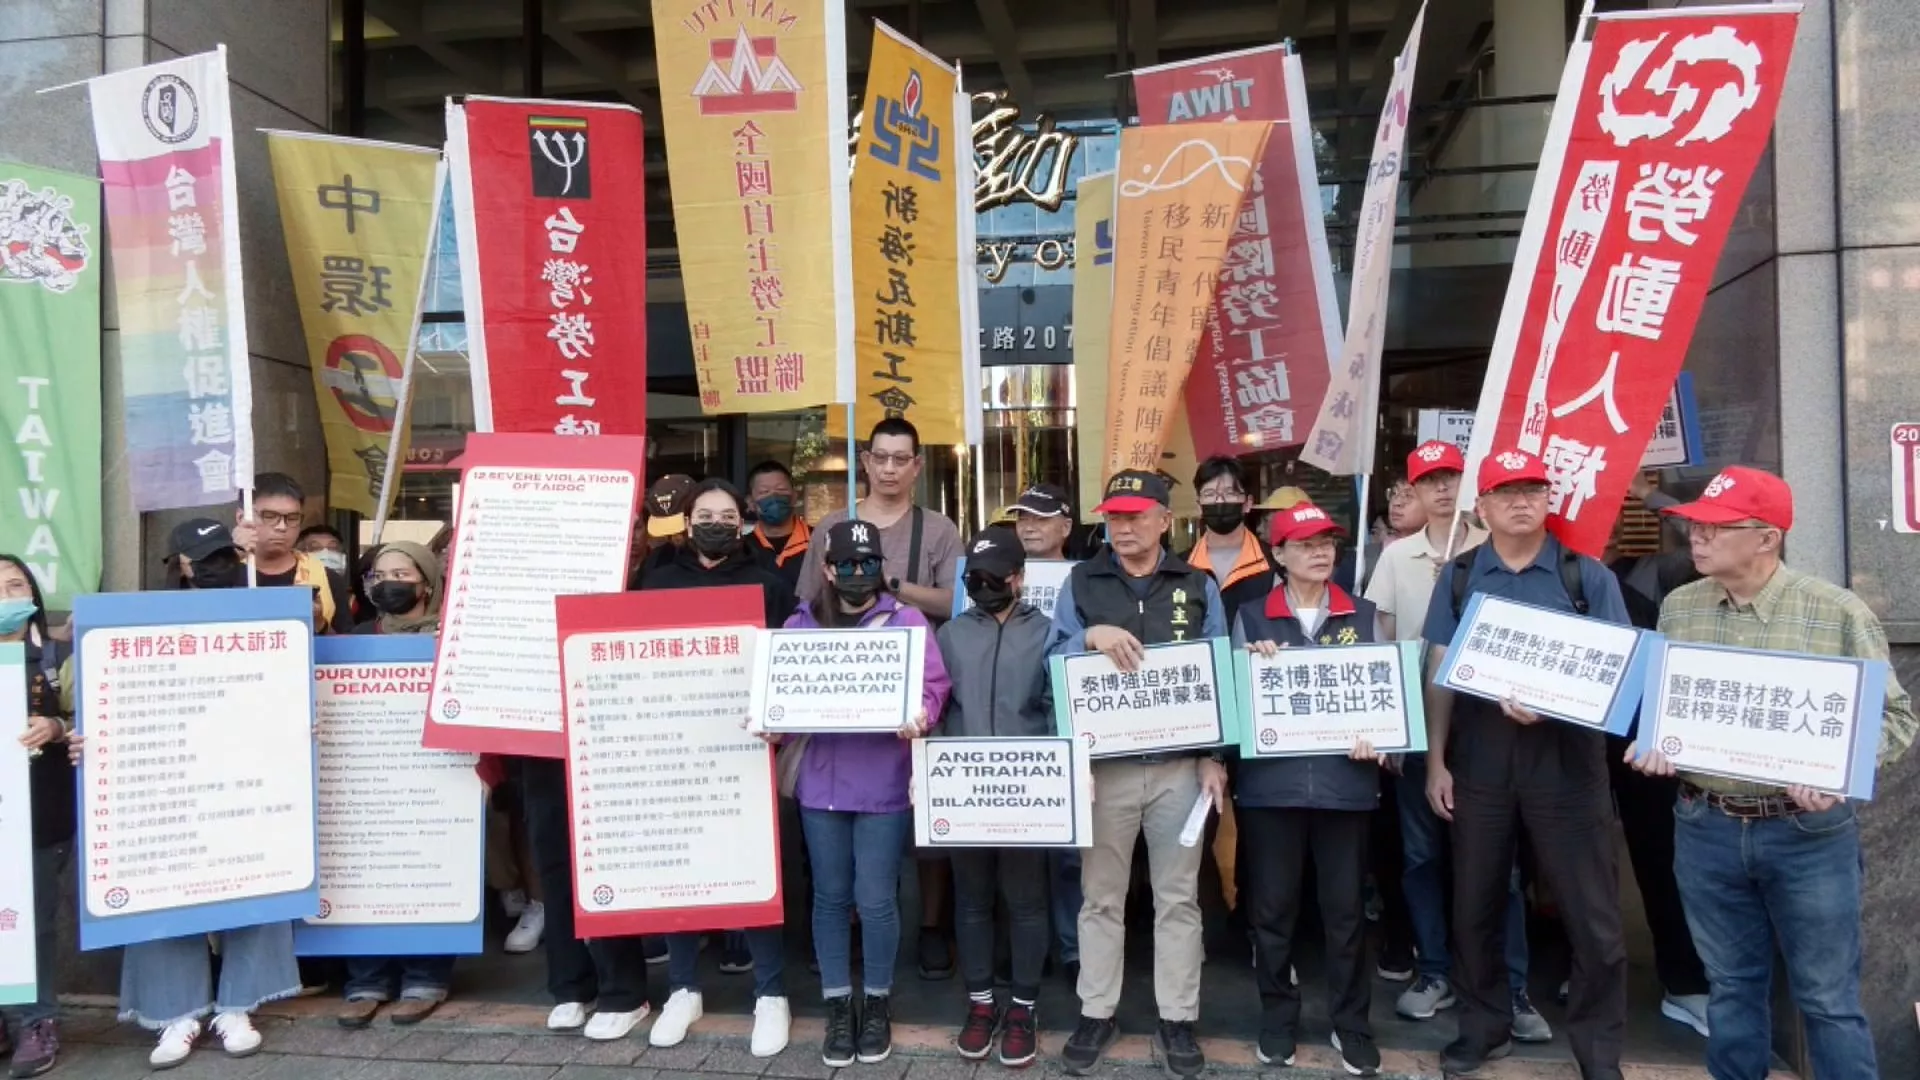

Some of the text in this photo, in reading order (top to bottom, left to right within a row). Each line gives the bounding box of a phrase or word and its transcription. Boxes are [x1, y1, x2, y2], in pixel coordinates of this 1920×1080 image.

[977, 240, 1016, 283] y
[164, 165, 233, 493] 台灣人權促進會
[1131, 201, 1192, 468] 移民青年倡議陣線
[1896, 428, 1919, 441] 20
[16, 376, 60, 593] TAIWAN
[491, 473, 541, 482] SEVERE
[545, 474, 629, 484] VIOLATIONS
[512, 482, 585, 493] OF TAIDOC
[109, 631, 288, 659] 我們公會14大訴求
[592, 635, 739, 662] 泰博12項重大違規
[778, 640, 898, 651] AYUSIN ANG
[773, 653, 900, 665] PATAKARAN
[1467, 636, 1617, 686] 團結抵抗勞權災難
[314, 668, 353, 680] OUR
[771, 672, 903, 682] IGALANG ANG
[1081, 663, 1201, 694] 泰博強迫勞動
[1260, 660, 1393, 691] 泰博濫收費
[333, 682, 430, 694] DEMAND
[776, 683, 896, 695] KARAPATAN
[1670, 673, 1848, 715] 醫療器材救人命
[1073, 684, 1213, 713] FORA品牌蒙羞
[1262, 690, 1396, 716] 工會站出來
[1666, 696, 1845, 740] 壓榨勞權要人命
[937, 751, 1055, 763] ANG DORM
[931, 766, 1065, 777] AY TIRAHAN.
[973, 784, 1026, 795] HINDI
[932, 797, 1066, 808] BILANGGUAN!
